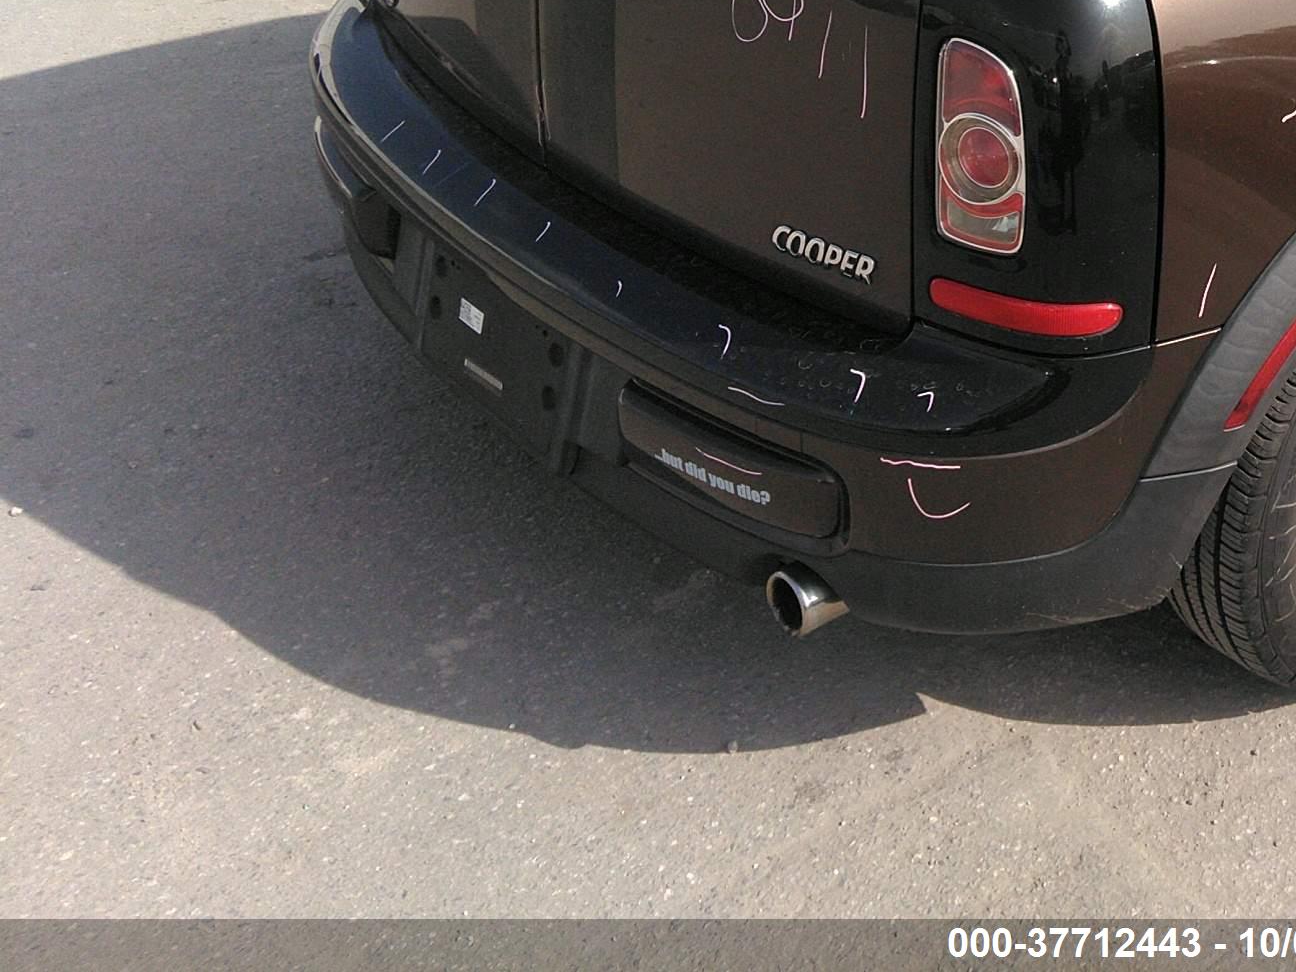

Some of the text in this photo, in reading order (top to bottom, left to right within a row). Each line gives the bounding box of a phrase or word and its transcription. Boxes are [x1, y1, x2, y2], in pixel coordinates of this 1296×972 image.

[771, 225, 876, 285] COOPER
[684, 460, 707, 483] did
[707, 473, 735, 495] you
